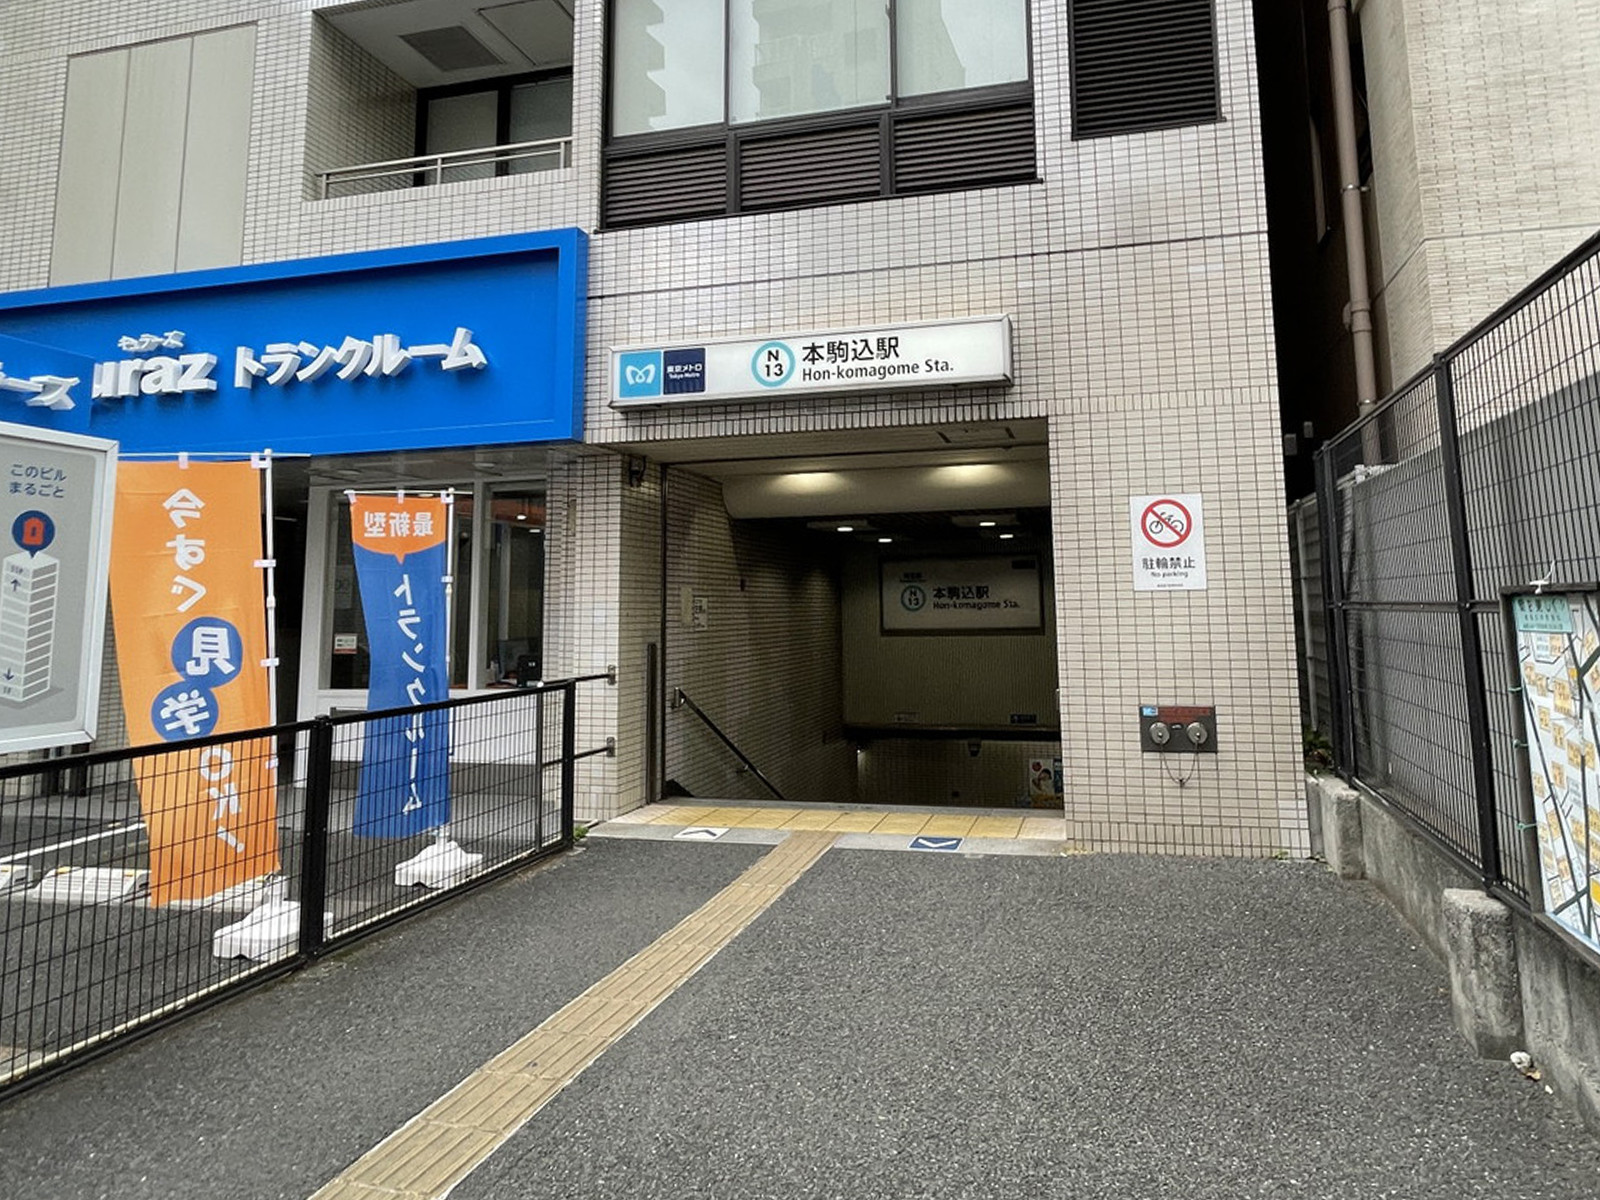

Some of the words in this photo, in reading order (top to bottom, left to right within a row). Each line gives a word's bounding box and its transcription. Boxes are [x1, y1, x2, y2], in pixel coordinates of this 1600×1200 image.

[234, 326, 487, 389] トランクルーム
[767, 349, 780, 362] N
[801, 336, 901, 365] 本駒込駅
[764, 363, 784, 378] 13
[802, 362, 920, 382] Hon-komagome
[924, 357, 955, 373] Sta.
[10, 463, 67, 481] このビル
[9, 481, 65, 498] まるごと
[1142, 556, 1196, 570] 駐輪禁止
[932, 585, 990, 600] 本駒込駅
